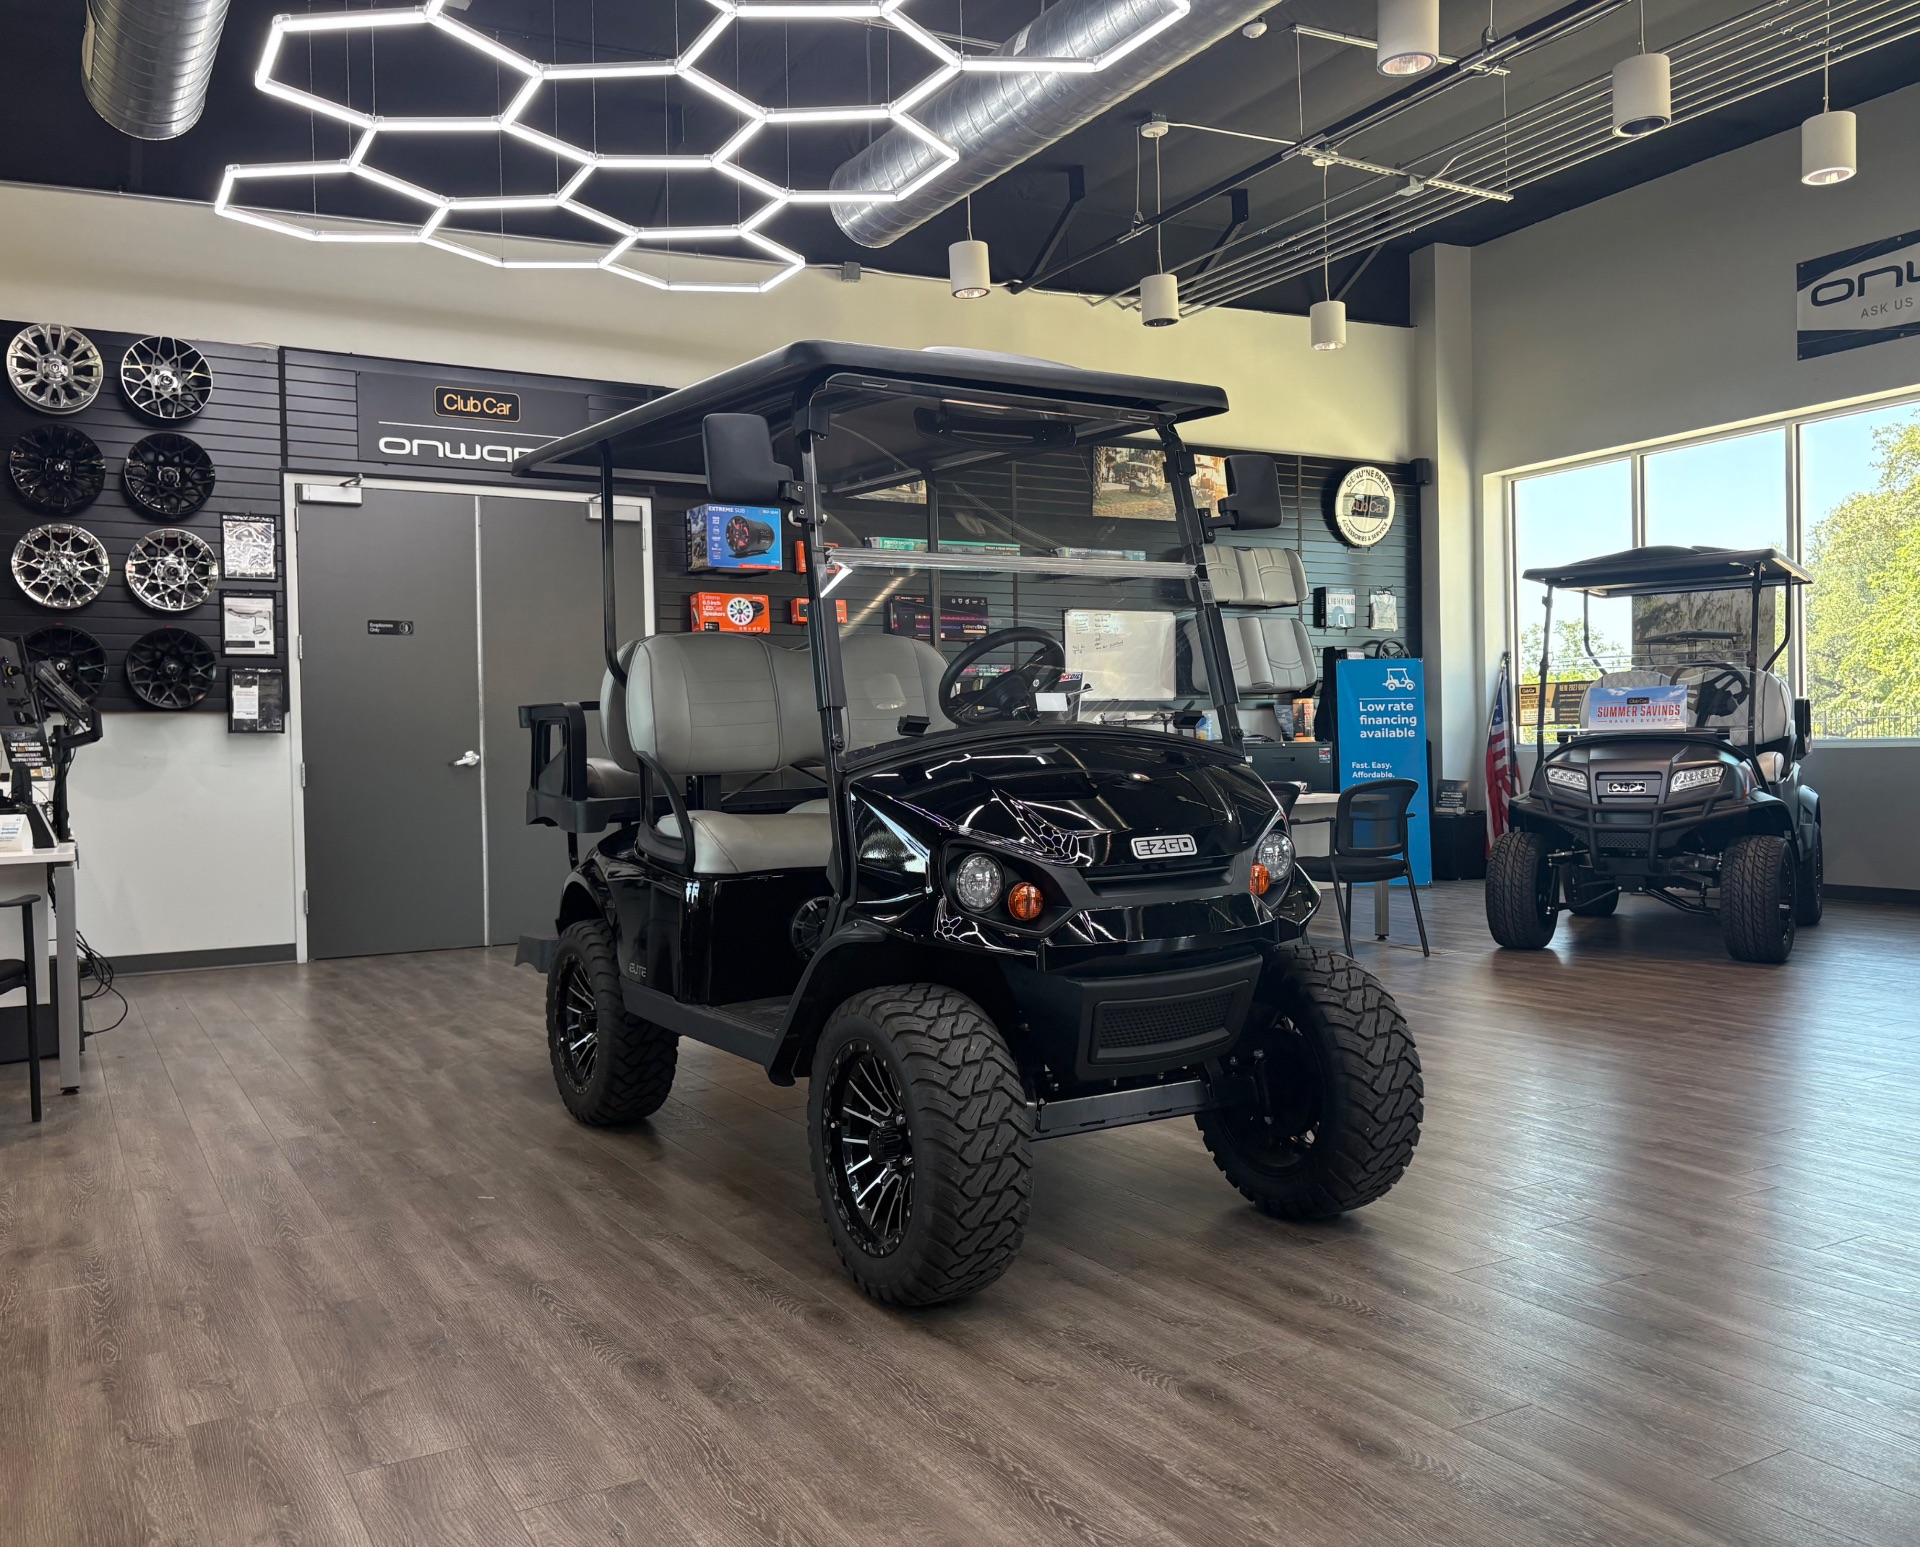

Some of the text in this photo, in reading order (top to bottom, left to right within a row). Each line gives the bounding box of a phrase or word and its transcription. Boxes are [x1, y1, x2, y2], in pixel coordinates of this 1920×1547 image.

[1861, 297, 1914, 318] ASK US
[443, 393, 512, 416] Club Car
[378, 437, 537, 463] onwar
[1375, 471, 1391, 492] PARTS
[708, 505, 734, 513] EXTREME
[1369, 501, 1386, 513] Car
[1371, 522, 1388, 541] SERVICE
[1327, 596, 1355, 606] LIGHTING
[1359, 701, 1414, 711] Low rate
[1597, 704, 1680, 718] SUMMER SAVINGS
[1359, 714, 1417, 727] financing
[1359, 727, 1415, 738] available
[1352, 761, 1392, 770] Fast. Easy.
